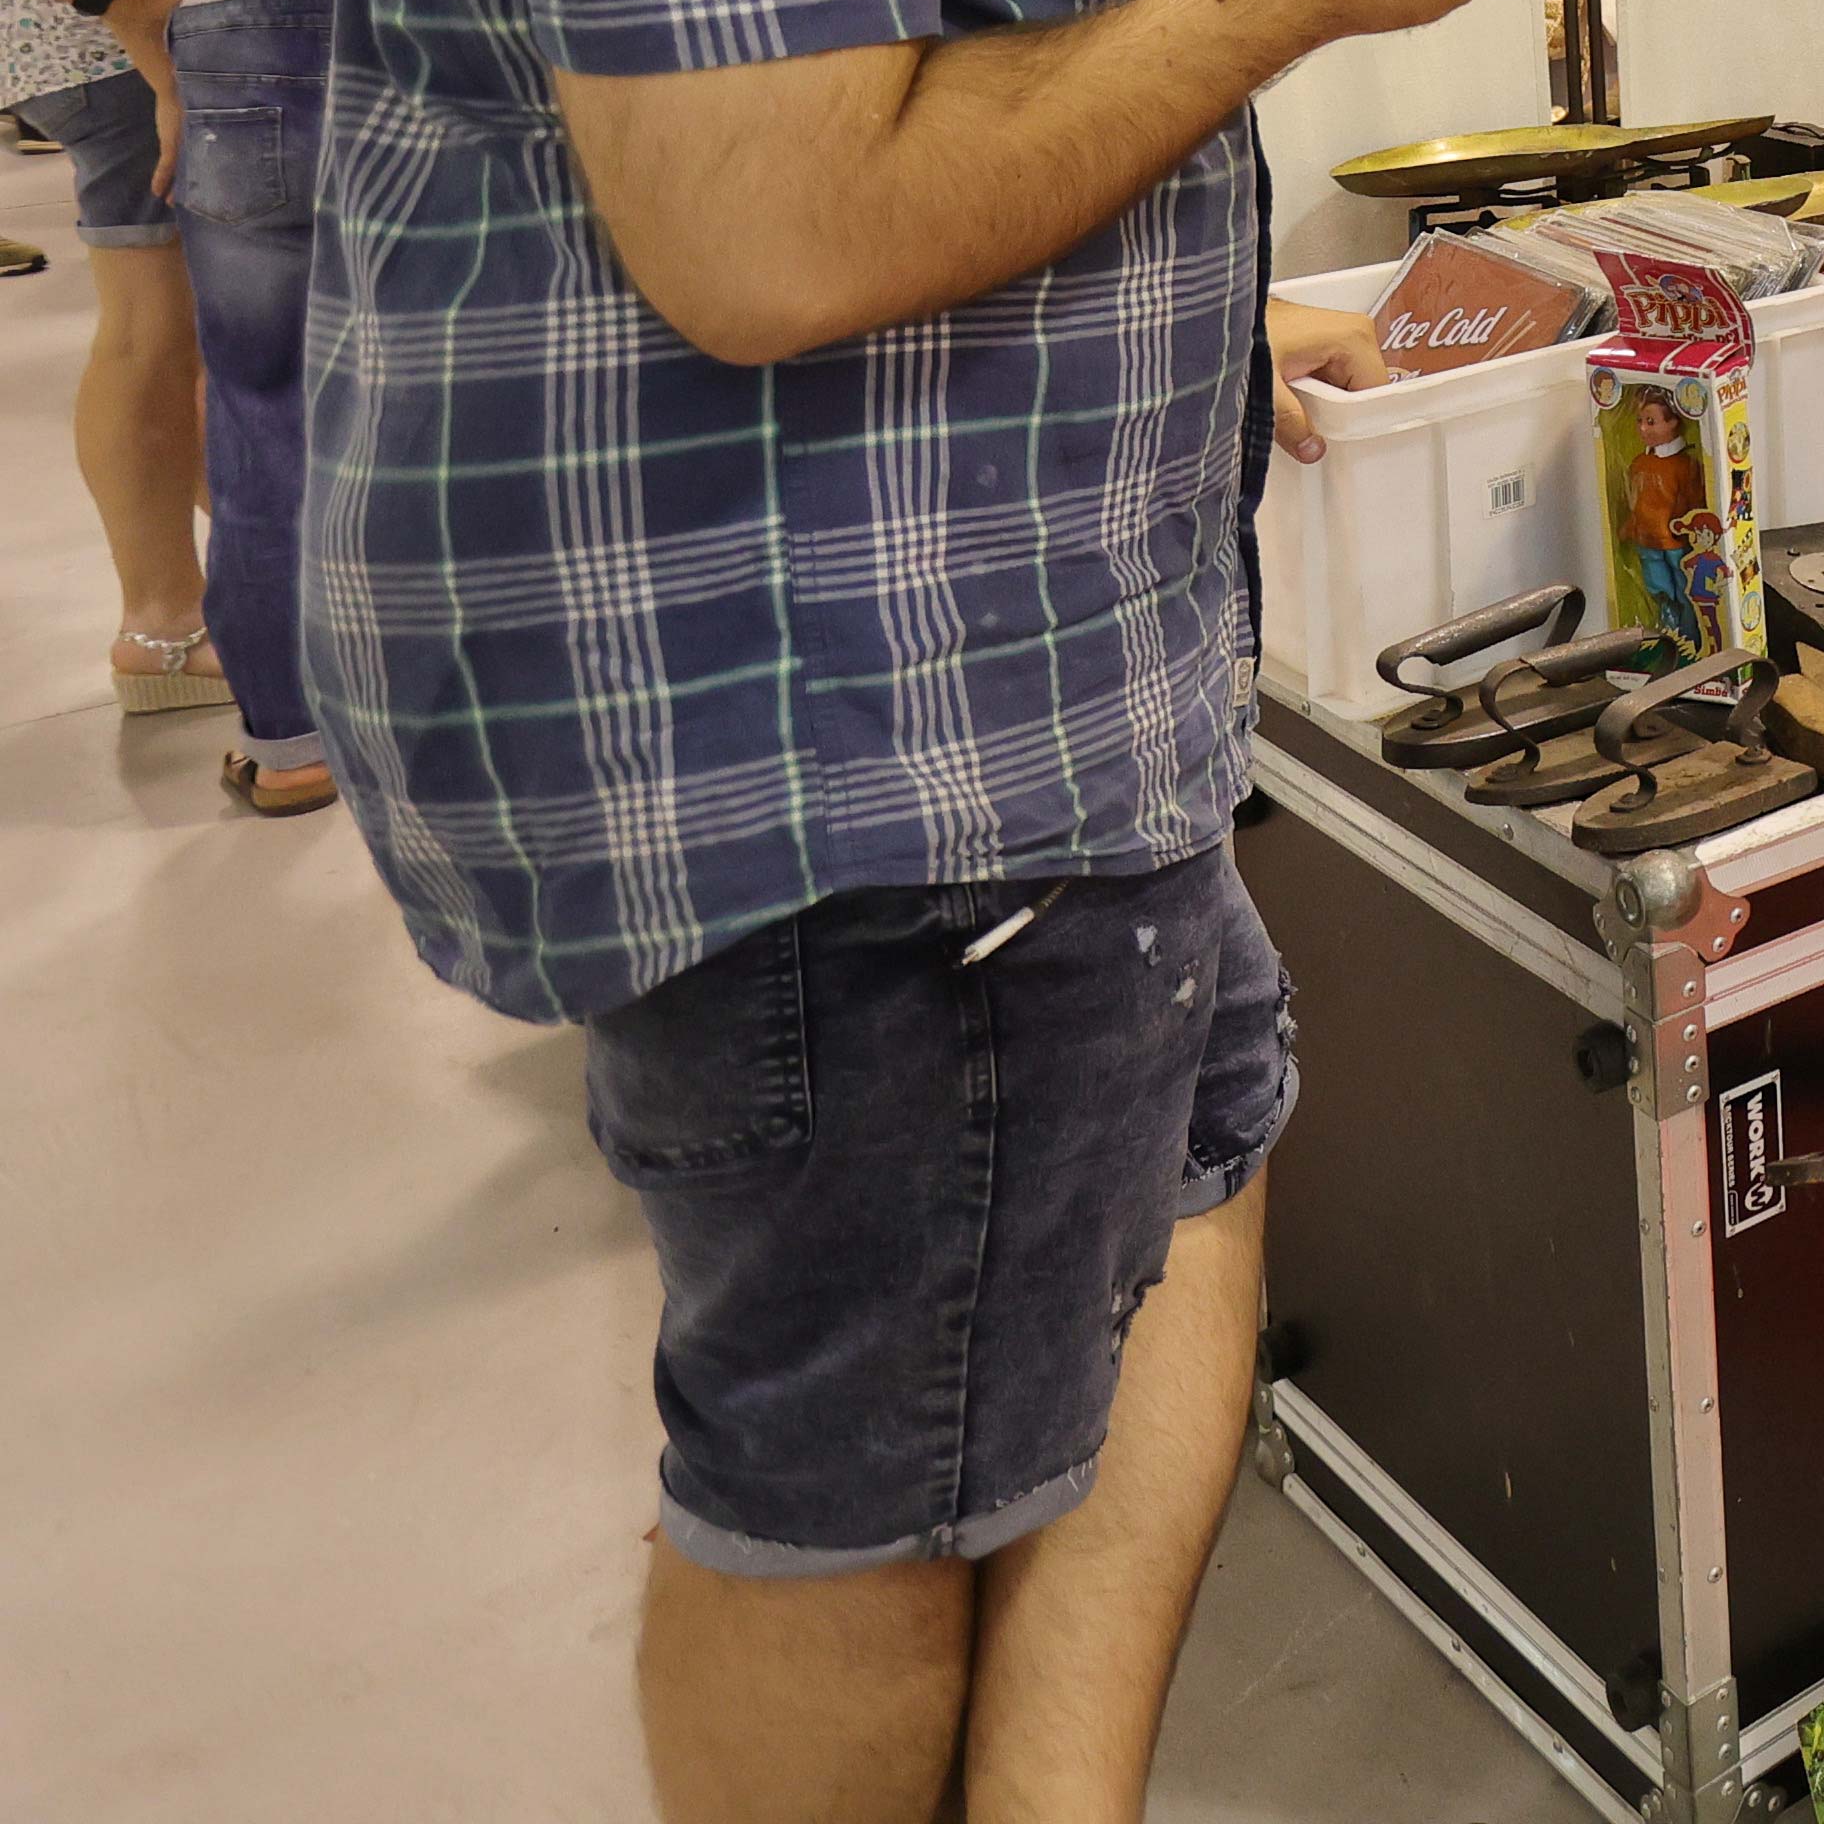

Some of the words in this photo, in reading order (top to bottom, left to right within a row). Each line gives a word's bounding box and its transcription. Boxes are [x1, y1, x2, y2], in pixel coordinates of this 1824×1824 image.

[1381, 311, 1430, 351] Ice
[1428, 306, 1508, 348] Cold
[1627, 290, 1731, 334] Pippi
[1693, 685, 1728, 698] Simba
[1746, 1091, 1766, 1181] WORK
